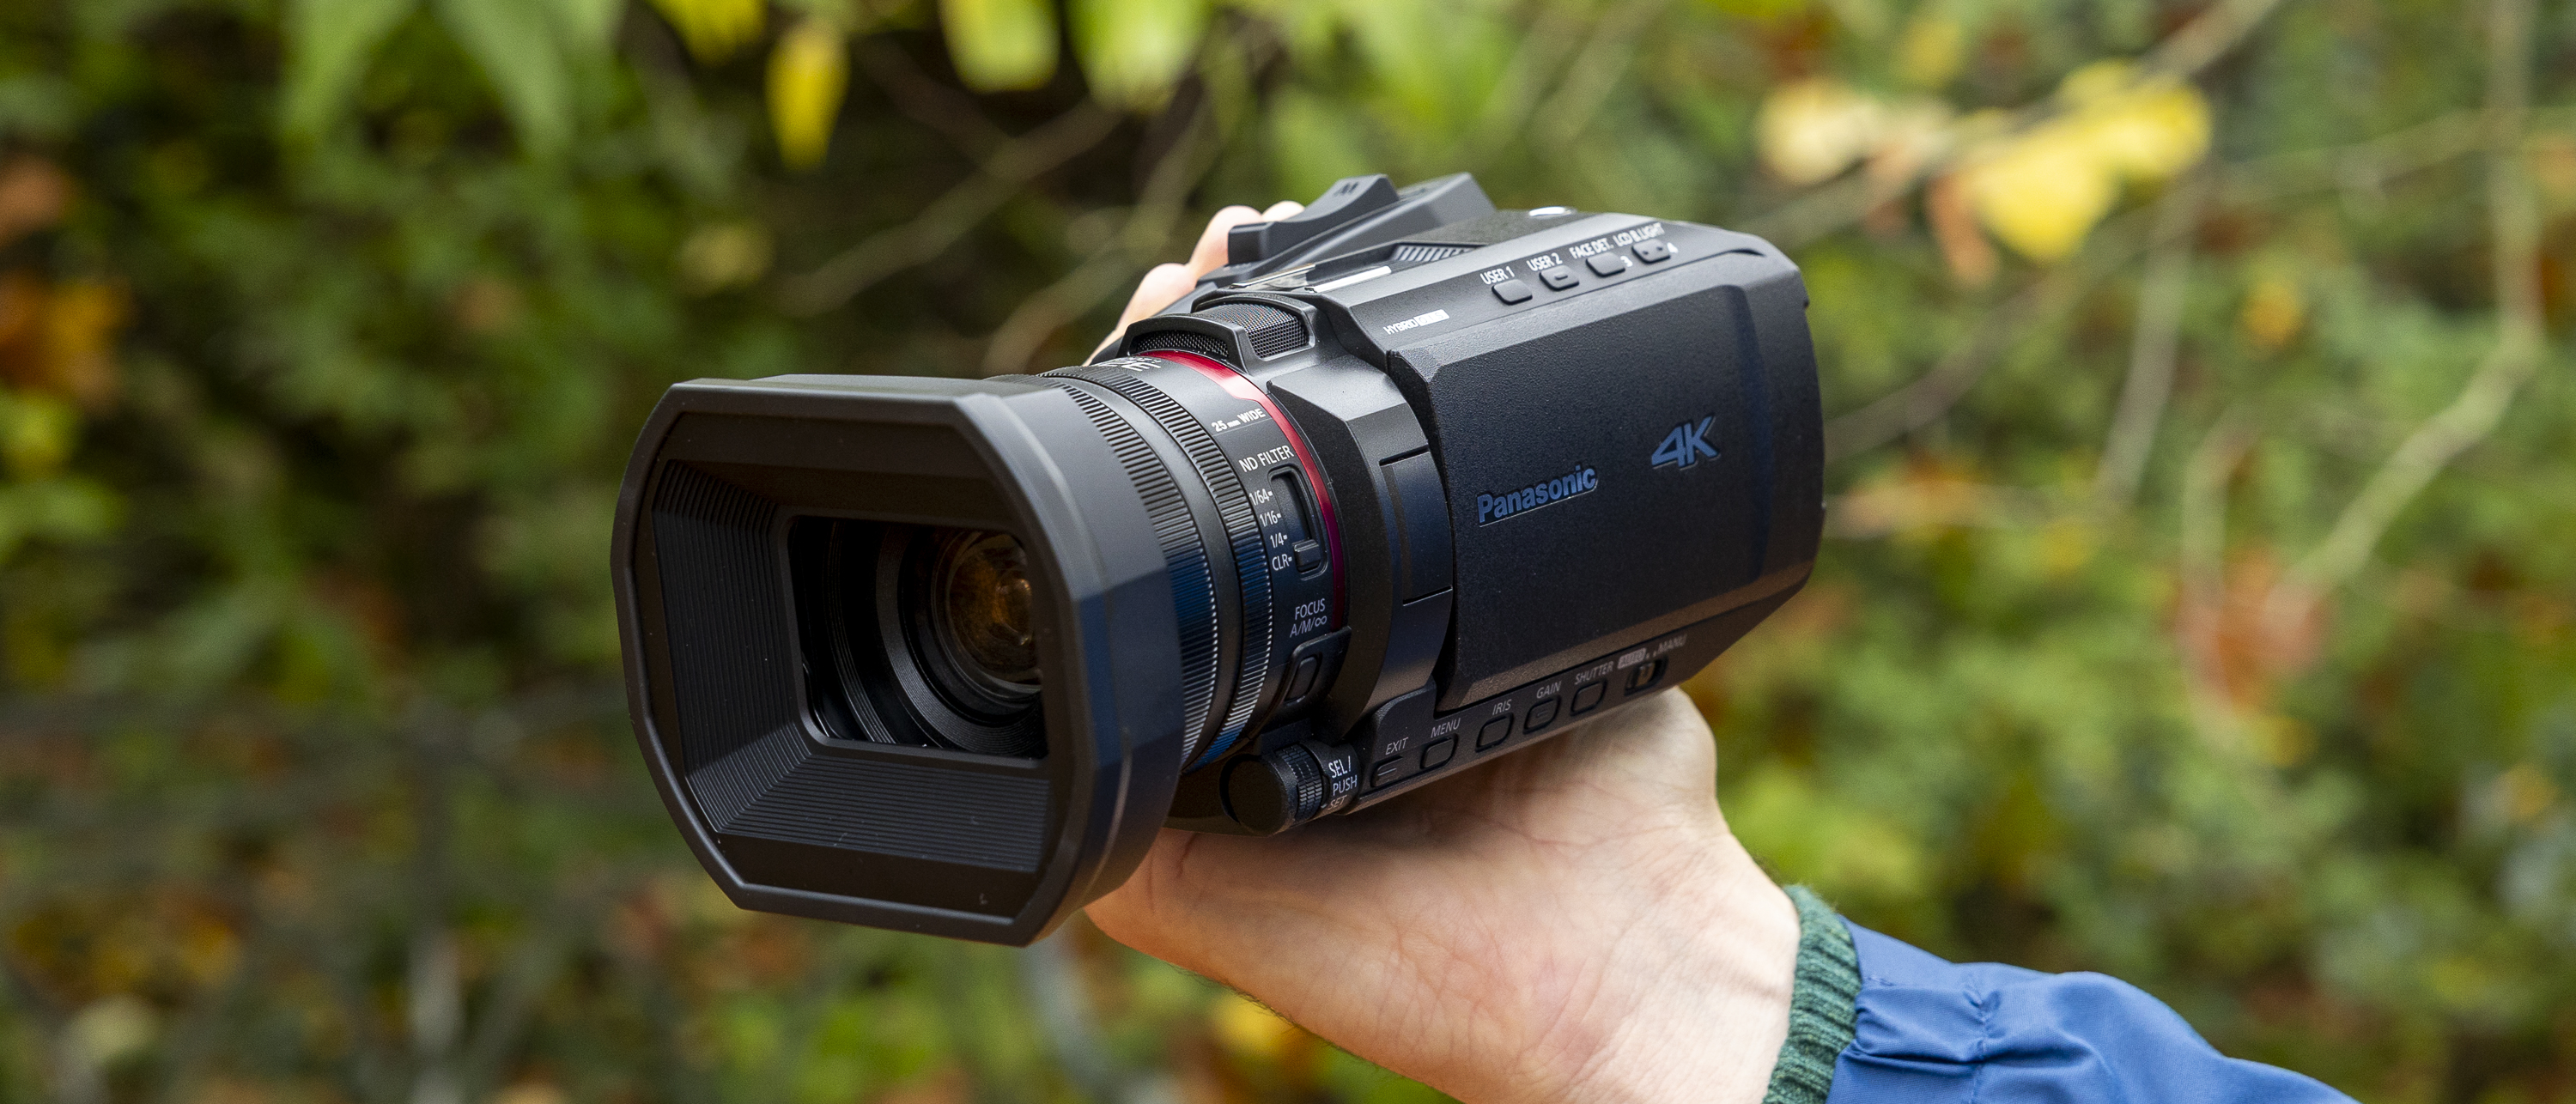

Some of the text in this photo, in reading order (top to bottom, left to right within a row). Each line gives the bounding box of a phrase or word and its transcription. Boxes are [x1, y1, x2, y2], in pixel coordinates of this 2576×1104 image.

[1569, 238, 1613, 259] FACE DET.
[1613, 232, 1633, 247] LCD
[1667, 242, 1679, 253] 4
[1527, 253, 1563, 272] USER 2
[1620, 256, 1633, 267] 3
[1480, 266, 1515, 285] USER 1
[1383, 318, 1419, 335] HYBRID
[1212, 408, 1266, 432] 25 mm WIDE
[1651, 416, 1718, 467] 4K
[1239, 445, 1294, 472] ND FILTER
[1249, 488, 1270, 506] 1/64
[1477, 464, 1596, 523] Panasonic
[1260, 510, 1278, 527] 1/16
[1270, 531, 1285, 549] 1/4
[1272, 554, 1290, 571] CLR
[1295, 598, 1326, 620] FOCUS
[1575, 661, 1613, 685] SHUTTER
[1536, 681, 1562, 699] GAIN
[1492, 699, 1512, 716] IRIS
[1431, 718, 1461, 738] MENU
[1385, 737, 1409, 755] EXIT
[1333, 775, 1358, 797] PUSH
[1328, 796, 1348, 810] SET
